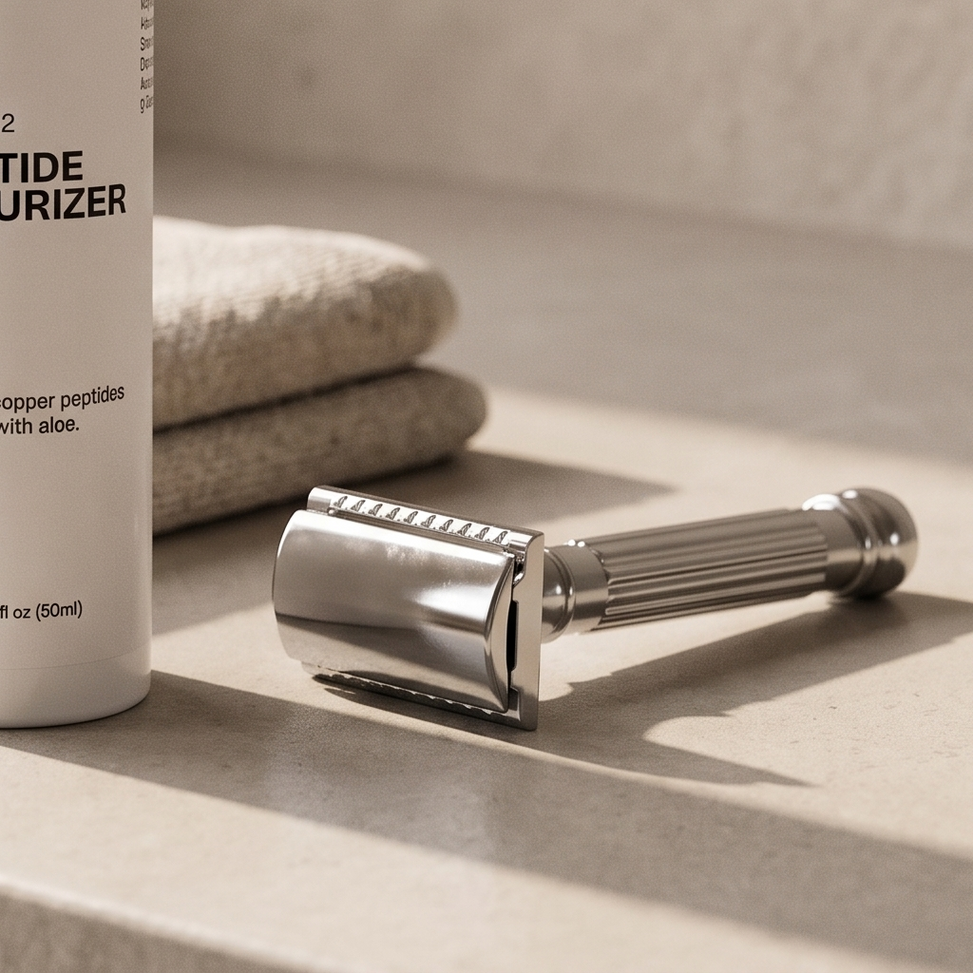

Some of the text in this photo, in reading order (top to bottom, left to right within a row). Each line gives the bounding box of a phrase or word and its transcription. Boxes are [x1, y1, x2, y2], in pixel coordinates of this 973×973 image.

[60, 384, 125, 412] peptides
[38, 416, 80, 435] aloe.
[0, 605, 9, 619] fl
[12, 607, 31, 620] oz
[35, 600, 83, 622] (50ml)
